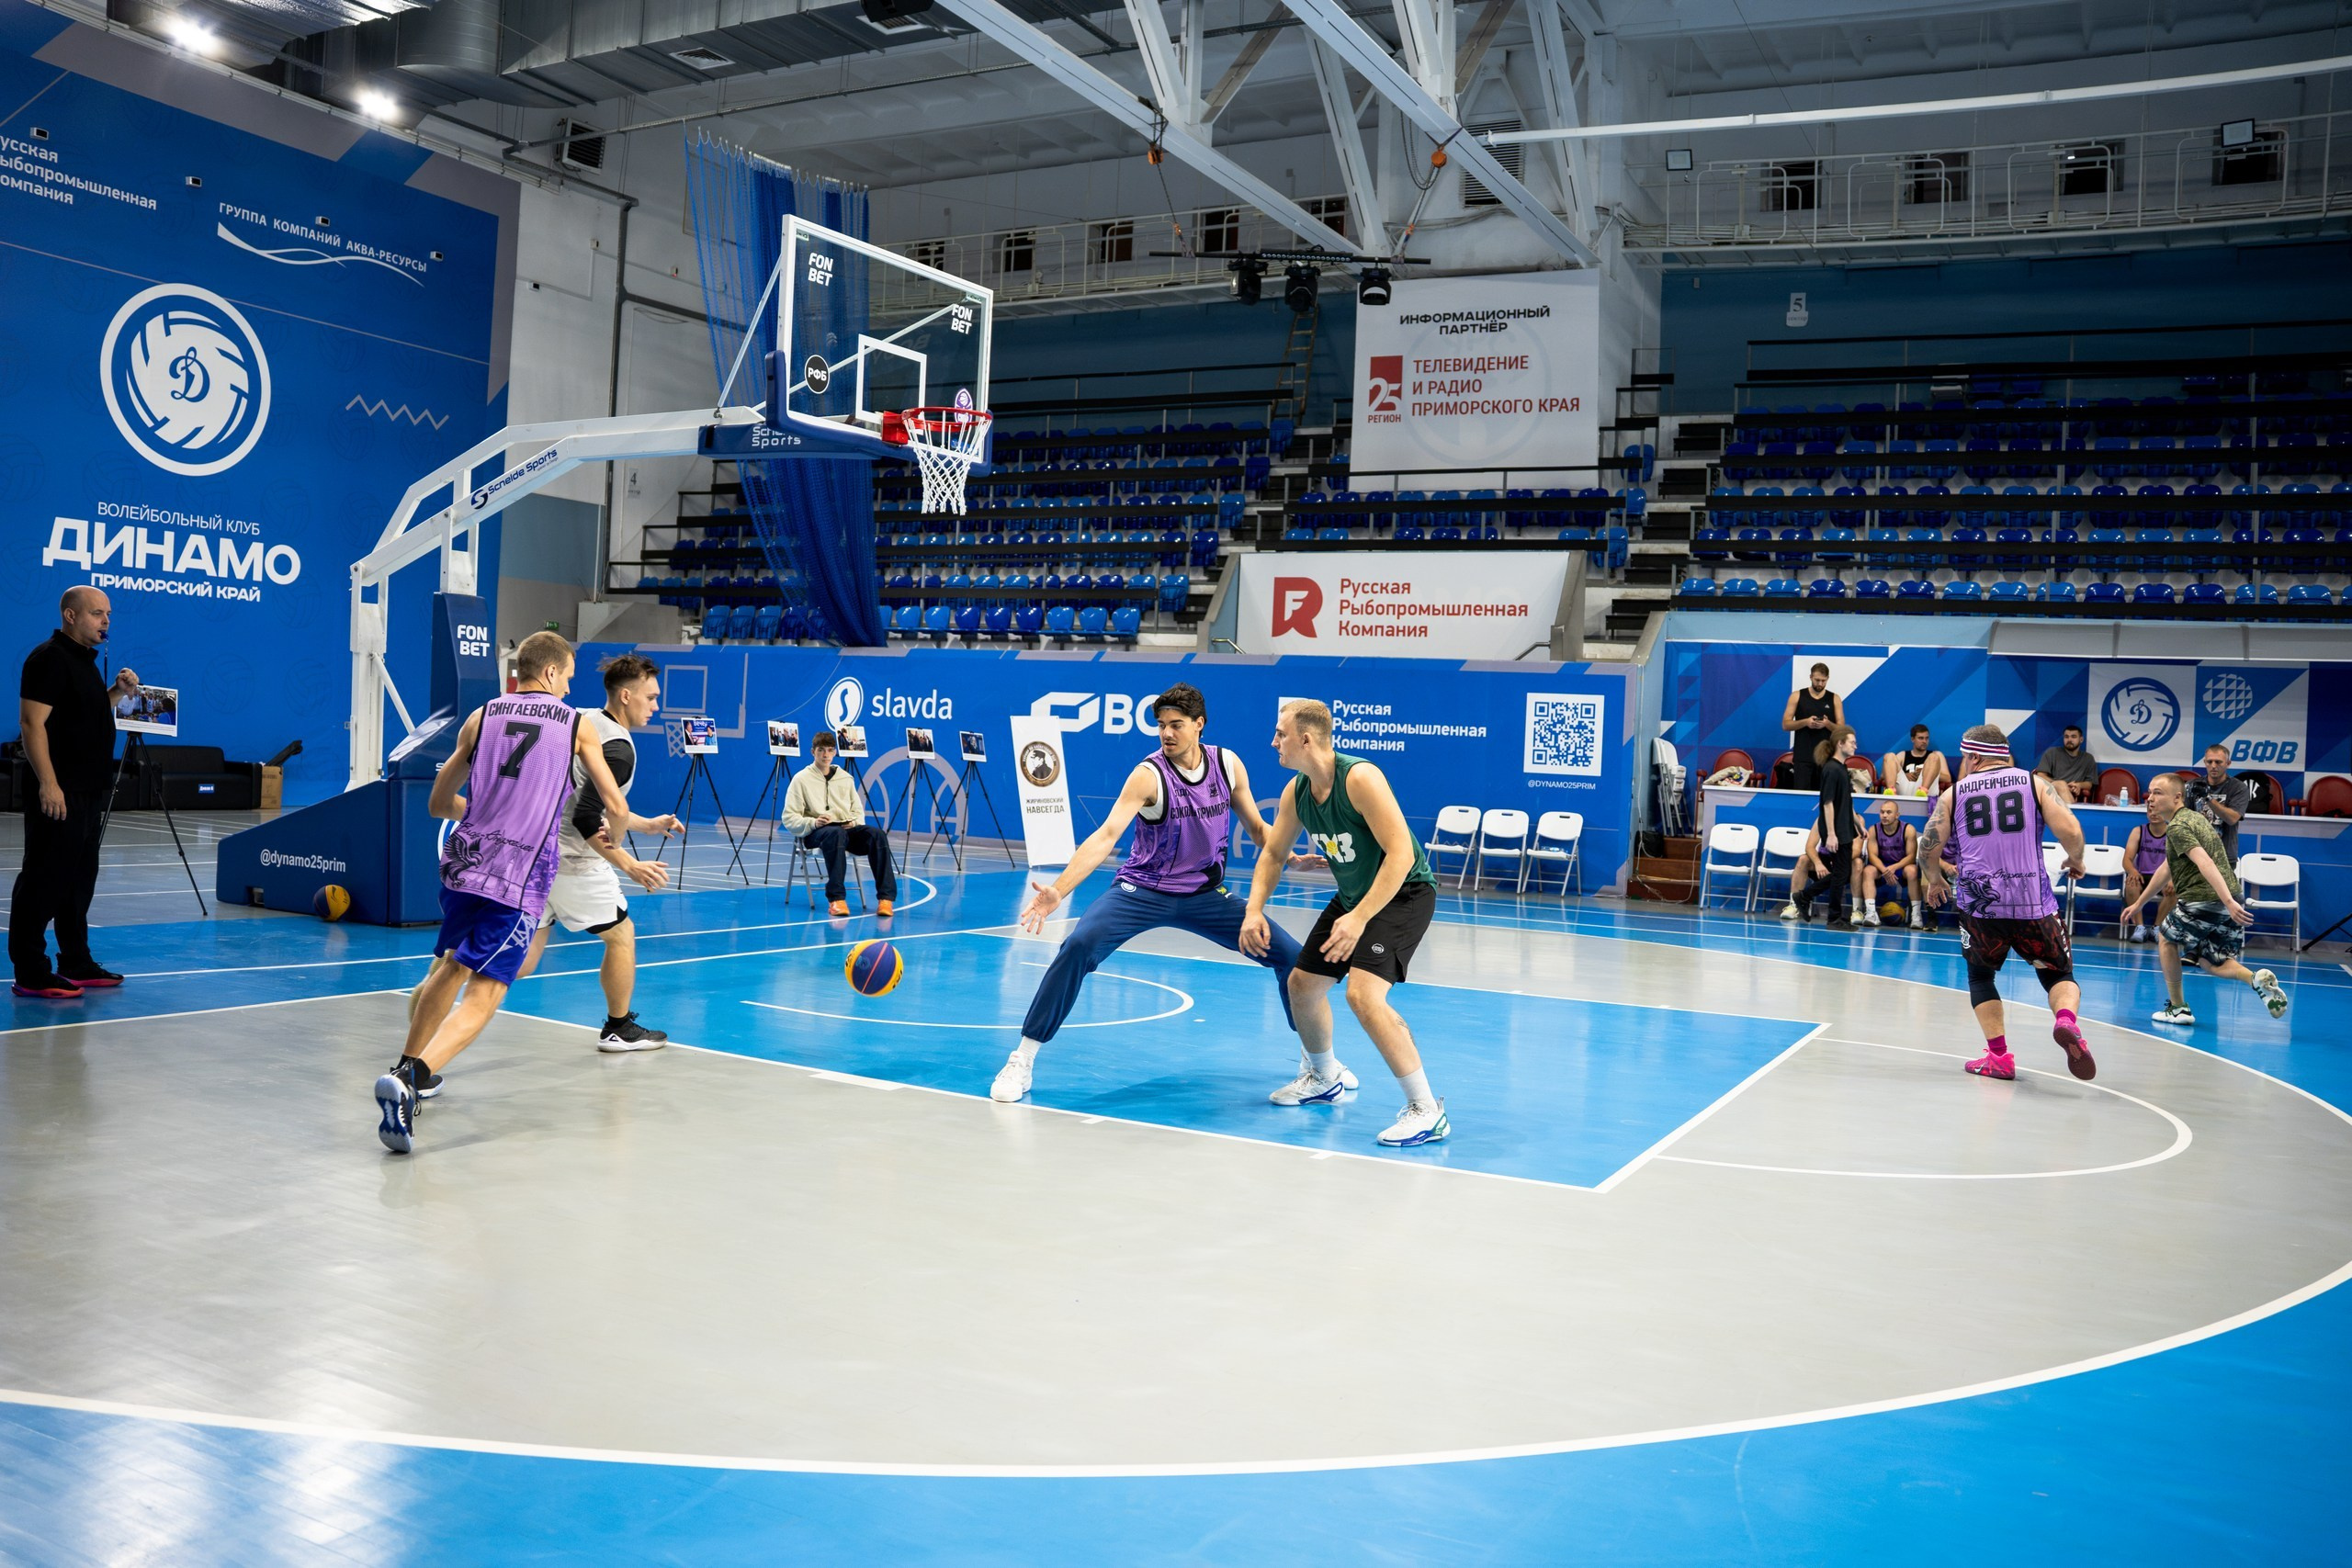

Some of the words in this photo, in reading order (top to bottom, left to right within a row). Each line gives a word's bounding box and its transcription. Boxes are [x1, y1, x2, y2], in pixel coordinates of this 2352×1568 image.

[0, 135, 58, 164] усская
[0, 154, 157, 210] ыбопромышленная
[0, 174, 74, 205] омпания
[219, 202, 267, 226] ГРУППА
[273, 218, 341, 247] КОМПАНИЙ
[345, 240, 427, 273] АКВА-РЕСУРСЫ
[808, 252, 834, 272] FON
[808, 267, 833, 287] BET
[951, 304, 973, 321] FON
[1399, 305, 1551, 325] ИНФОРМАЦИОННЫЙ
[1792, 298, 1803, 312] 5
[950, 318, 973, 335] BET
[1439, 319, 1509, 336] ПАРТНЁР
[808, 367, 827, 381] РФБ
[1412, 355, 1530, 375] ТЕЛЕВИДЕНИЕ
[1412, 381, 1423, 395] И
[1428, 378, 1483, 397] РАДИО
[1411, 399, 1533, 416] ПРИМОРСКОГО
[1538, 397, 1580, 412] КРАЯ
[1367, 413, 1402, 423] РЕГИОН
[752, 434, 801, 449] Sports
[526, 449, 558, 473] Sports
[97, 502, 222, 531] ВОЛЕЙБОЛЬНЫЙ
[226, 519, 261, 536] КЛУБ
[42, 516, 301, 585] ДИНАМО
[90, 572, 212, 598] ПРИМОРСКИЙ
[216, 586, 261, 602] КРАЙ
[1340, 578, 1411, 599] Русская
[1339, 598, 1529, 621] Рыбопромышленная
[457, 624, 488, 641] FON
[1338, 619, 1428, 638] Компания
[459, 640, 491, 657] BET
[871, 687, 953, 720] slavda
[1332, 699, 1392, 717] Русская
[488, 703, 571, 725] СИНГАЕВСКИЙ
[1332, 716, 1487, 738] Рыбопромышленная
[499, 720, 544, 780] 7
[1332, 735, 1405, 751] Компания
[2231, 739, 2299, 764] ВФВ
[1527, 779, 1596, 790] @DYNAMO25PRIM
[1959, 774, 2029, 795] АНДРЕЙЧЕНКО
[1964, 790, 2026, 838] 88
[260, 849, 346, 874] @dynamo25prim
